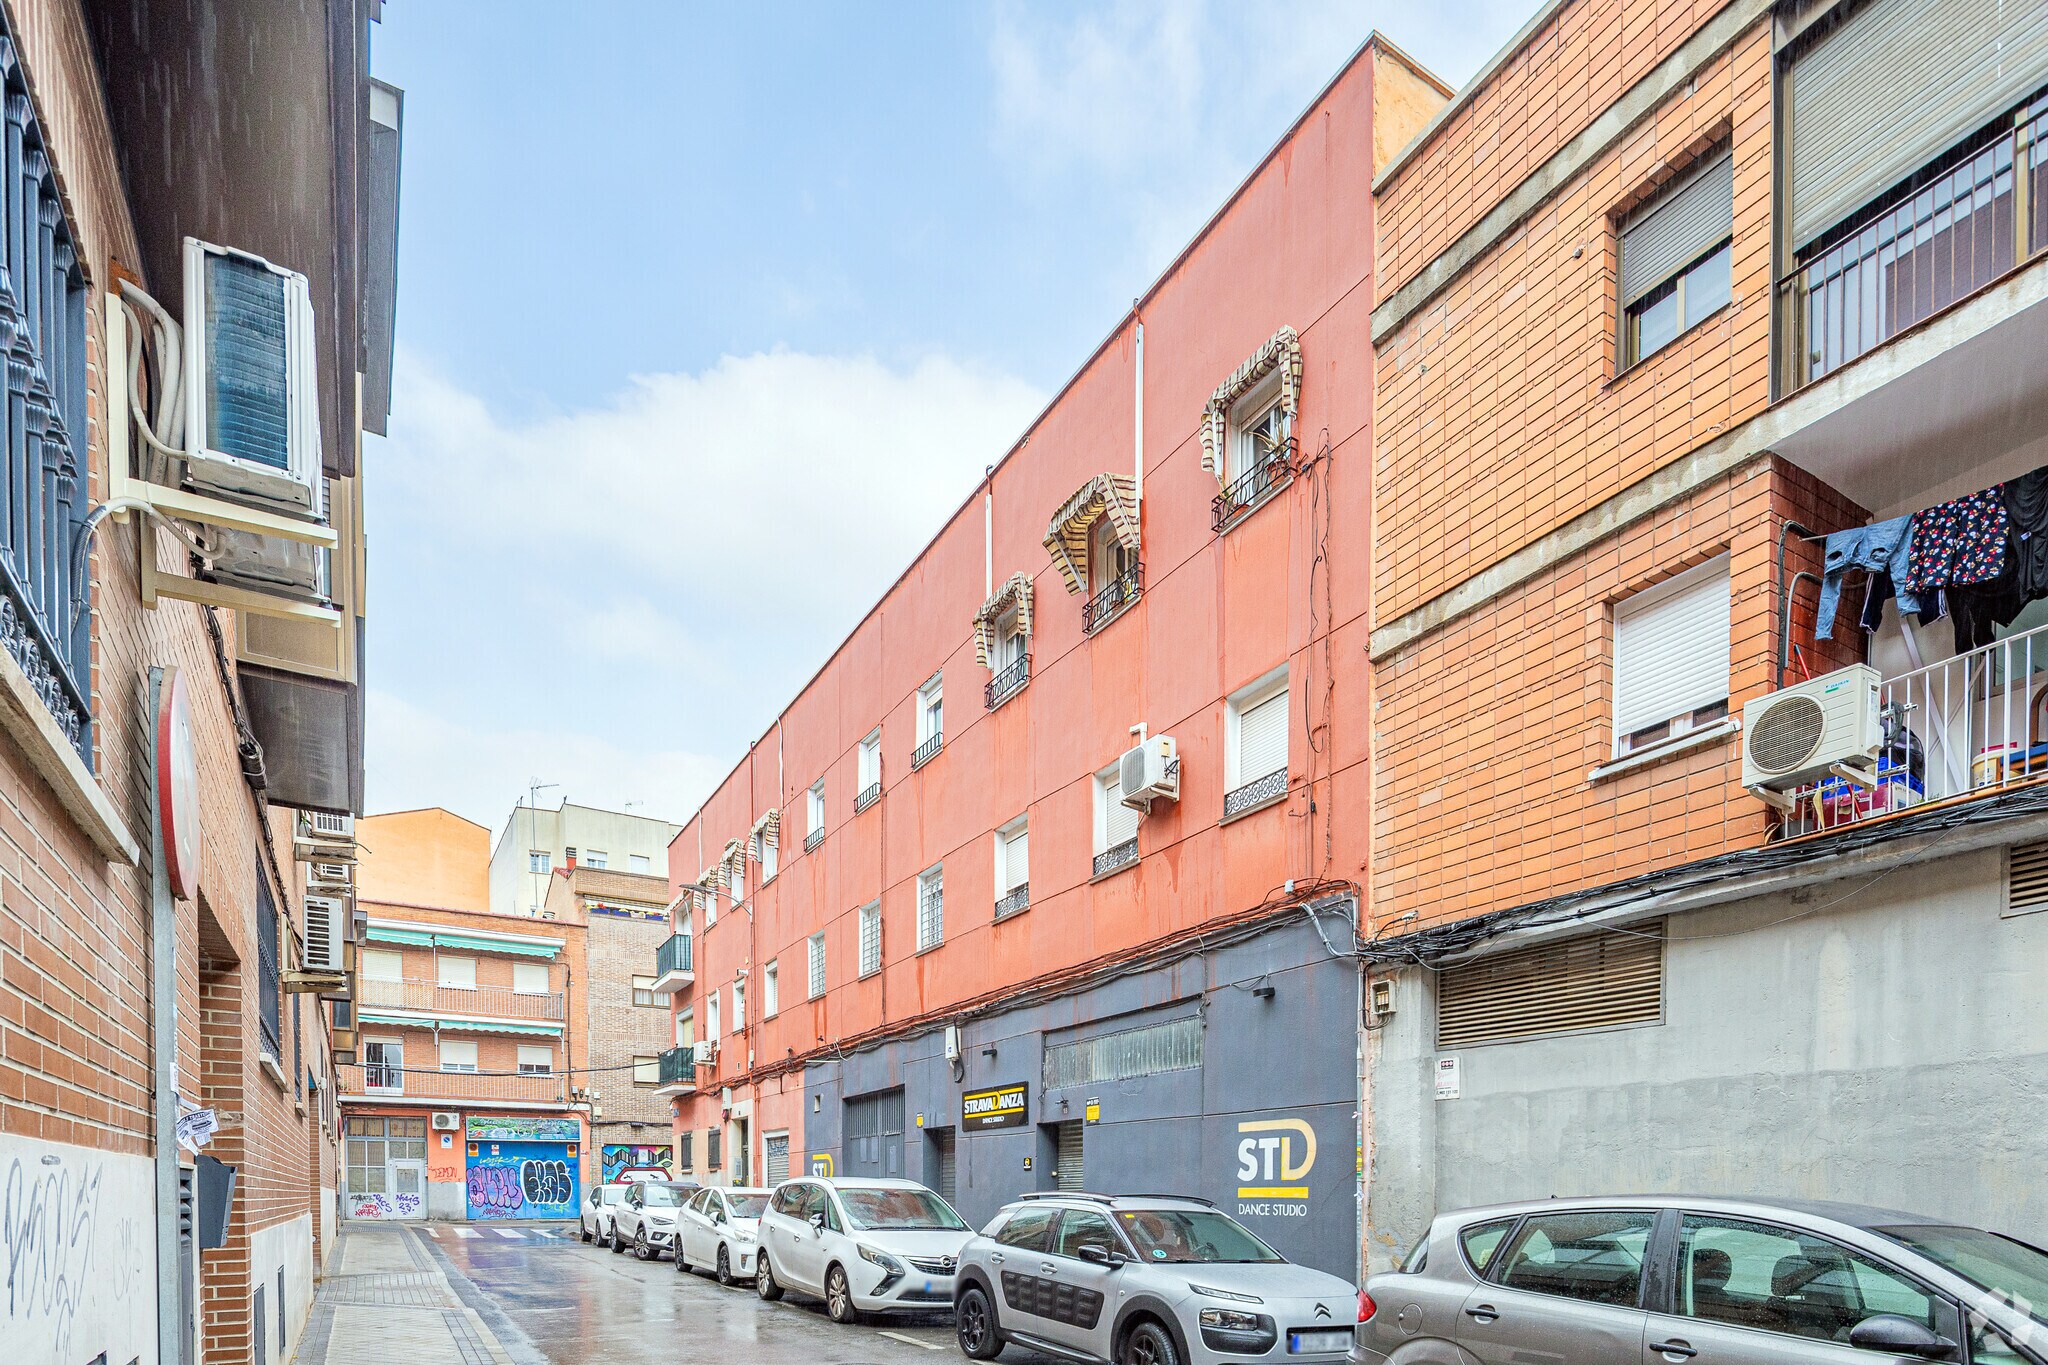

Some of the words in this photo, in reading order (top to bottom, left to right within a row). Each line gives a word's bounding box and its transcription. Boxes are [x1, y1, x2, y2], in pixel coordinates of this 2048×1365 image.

[964, 1091, 1025, 1114] STRAVADANZA
[1237, 1118, 1317, 1182] STD
[1238, 1203, 1270, 1216] DANCE
[1272, 1204, 1308, 1217] STUDIO
